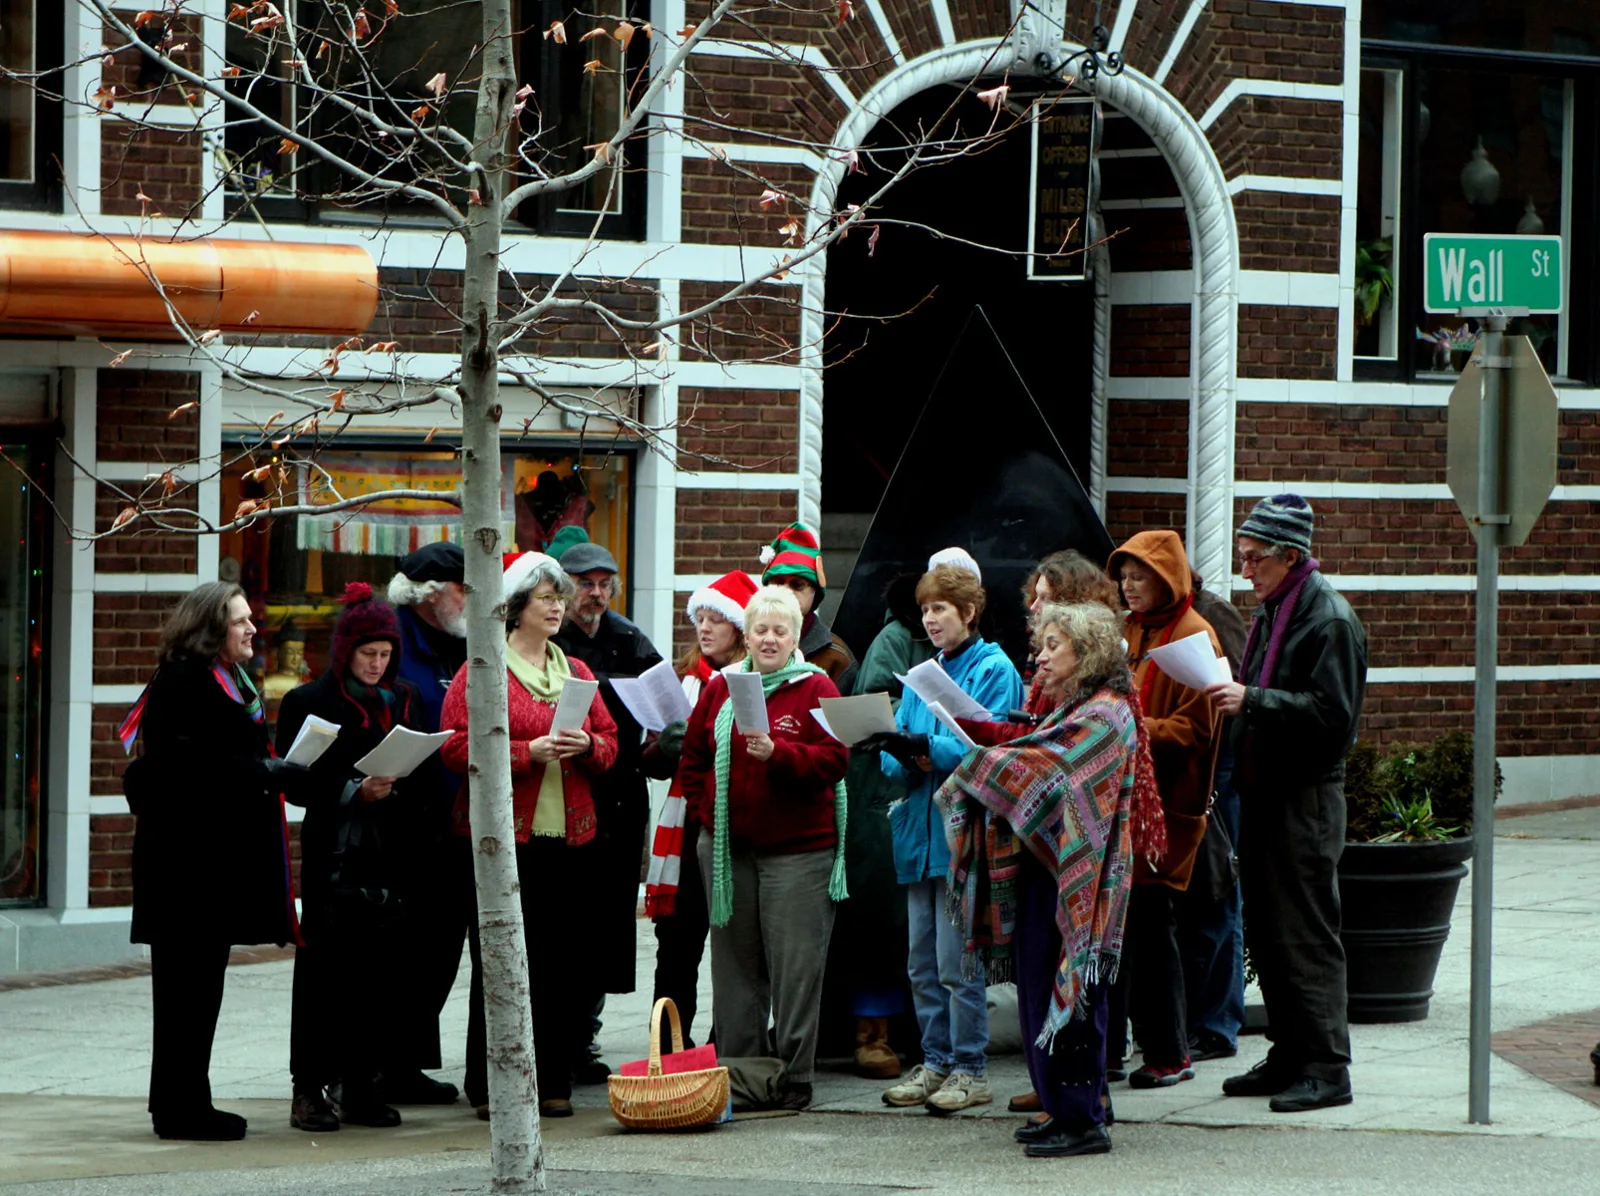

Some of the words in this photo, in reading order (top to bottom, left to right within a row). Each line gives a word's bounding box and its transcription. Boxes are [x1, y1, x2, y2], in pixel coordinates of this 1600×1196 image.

[1043, 115, 1090, 134] ENTRANCE
[1060, 135, 1072, 145] TO
[1043, 146, 1088, 164] OFFICES
[1041, 188, 1086, 214] MILES
[1438, 247, 1503, 303] Wall
[1531, 249, 1550, 277] St
